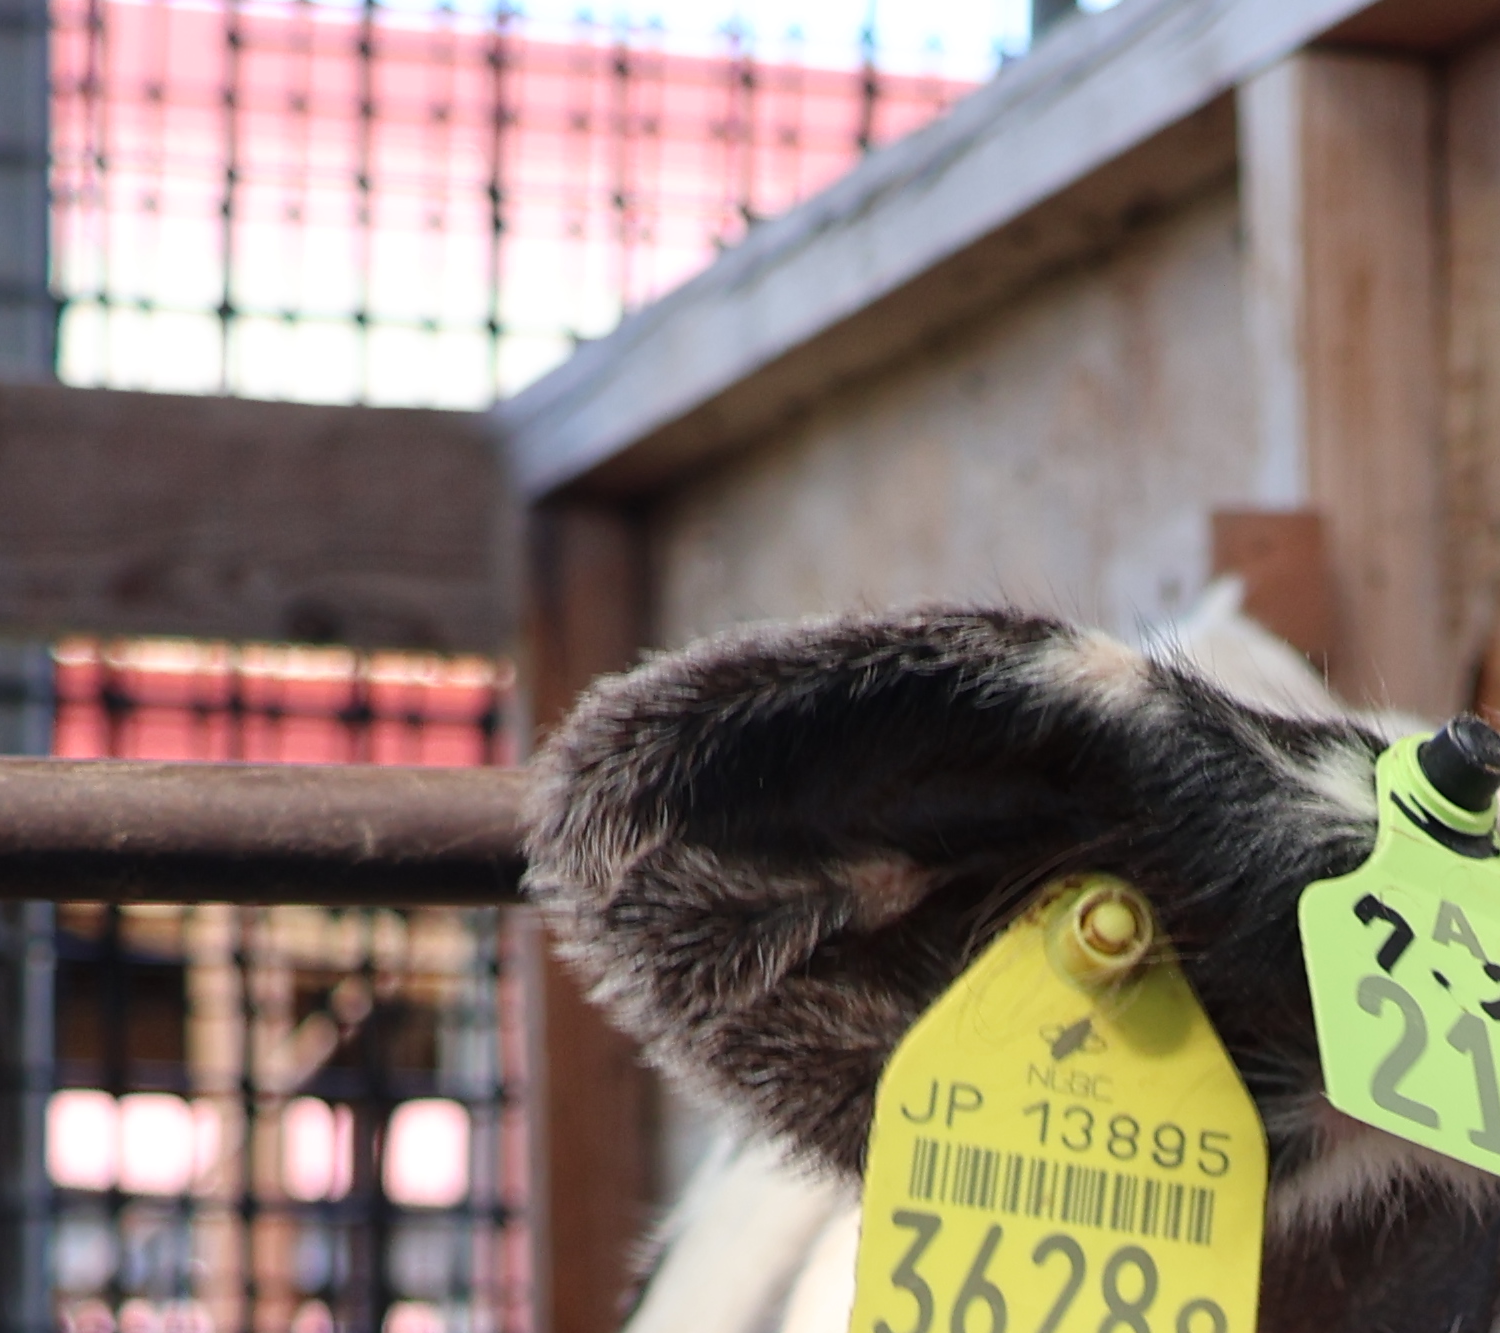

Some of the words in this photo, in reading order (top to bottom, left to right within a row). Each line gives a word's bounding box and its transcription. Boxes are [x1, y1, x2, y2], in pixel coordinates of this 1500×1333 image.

[1431, 900, 1487, 961] A
[900, 1079, 984, 1128] JP
[1022, 1099, 1231, 1178] 13895
